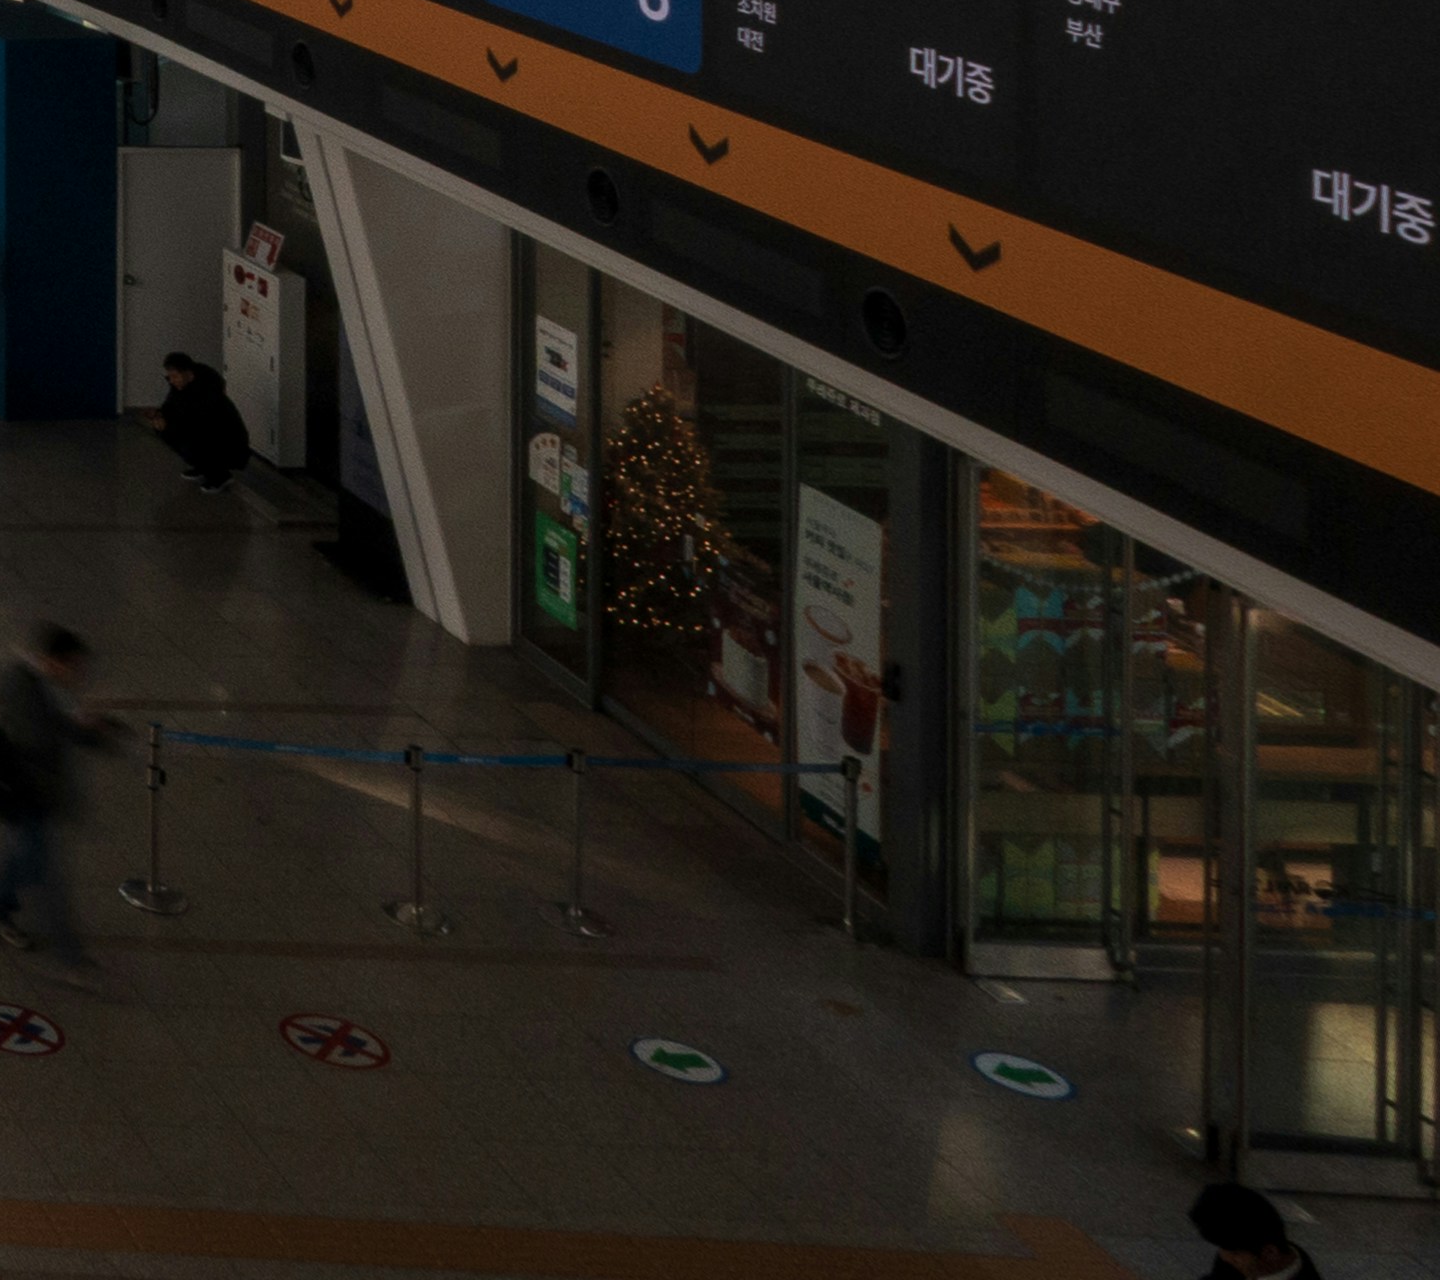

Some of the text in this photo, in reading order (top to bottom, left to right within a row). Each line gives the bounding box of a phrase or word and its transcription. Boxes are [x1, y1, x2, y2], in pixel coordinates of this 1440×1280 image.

[737, 27, 764, 53] 대전
[1065, 18, 1103, 49] 부산
[908, 47, 995, 105] 대기중
[1311, 168, 1435, 245] 대기중
